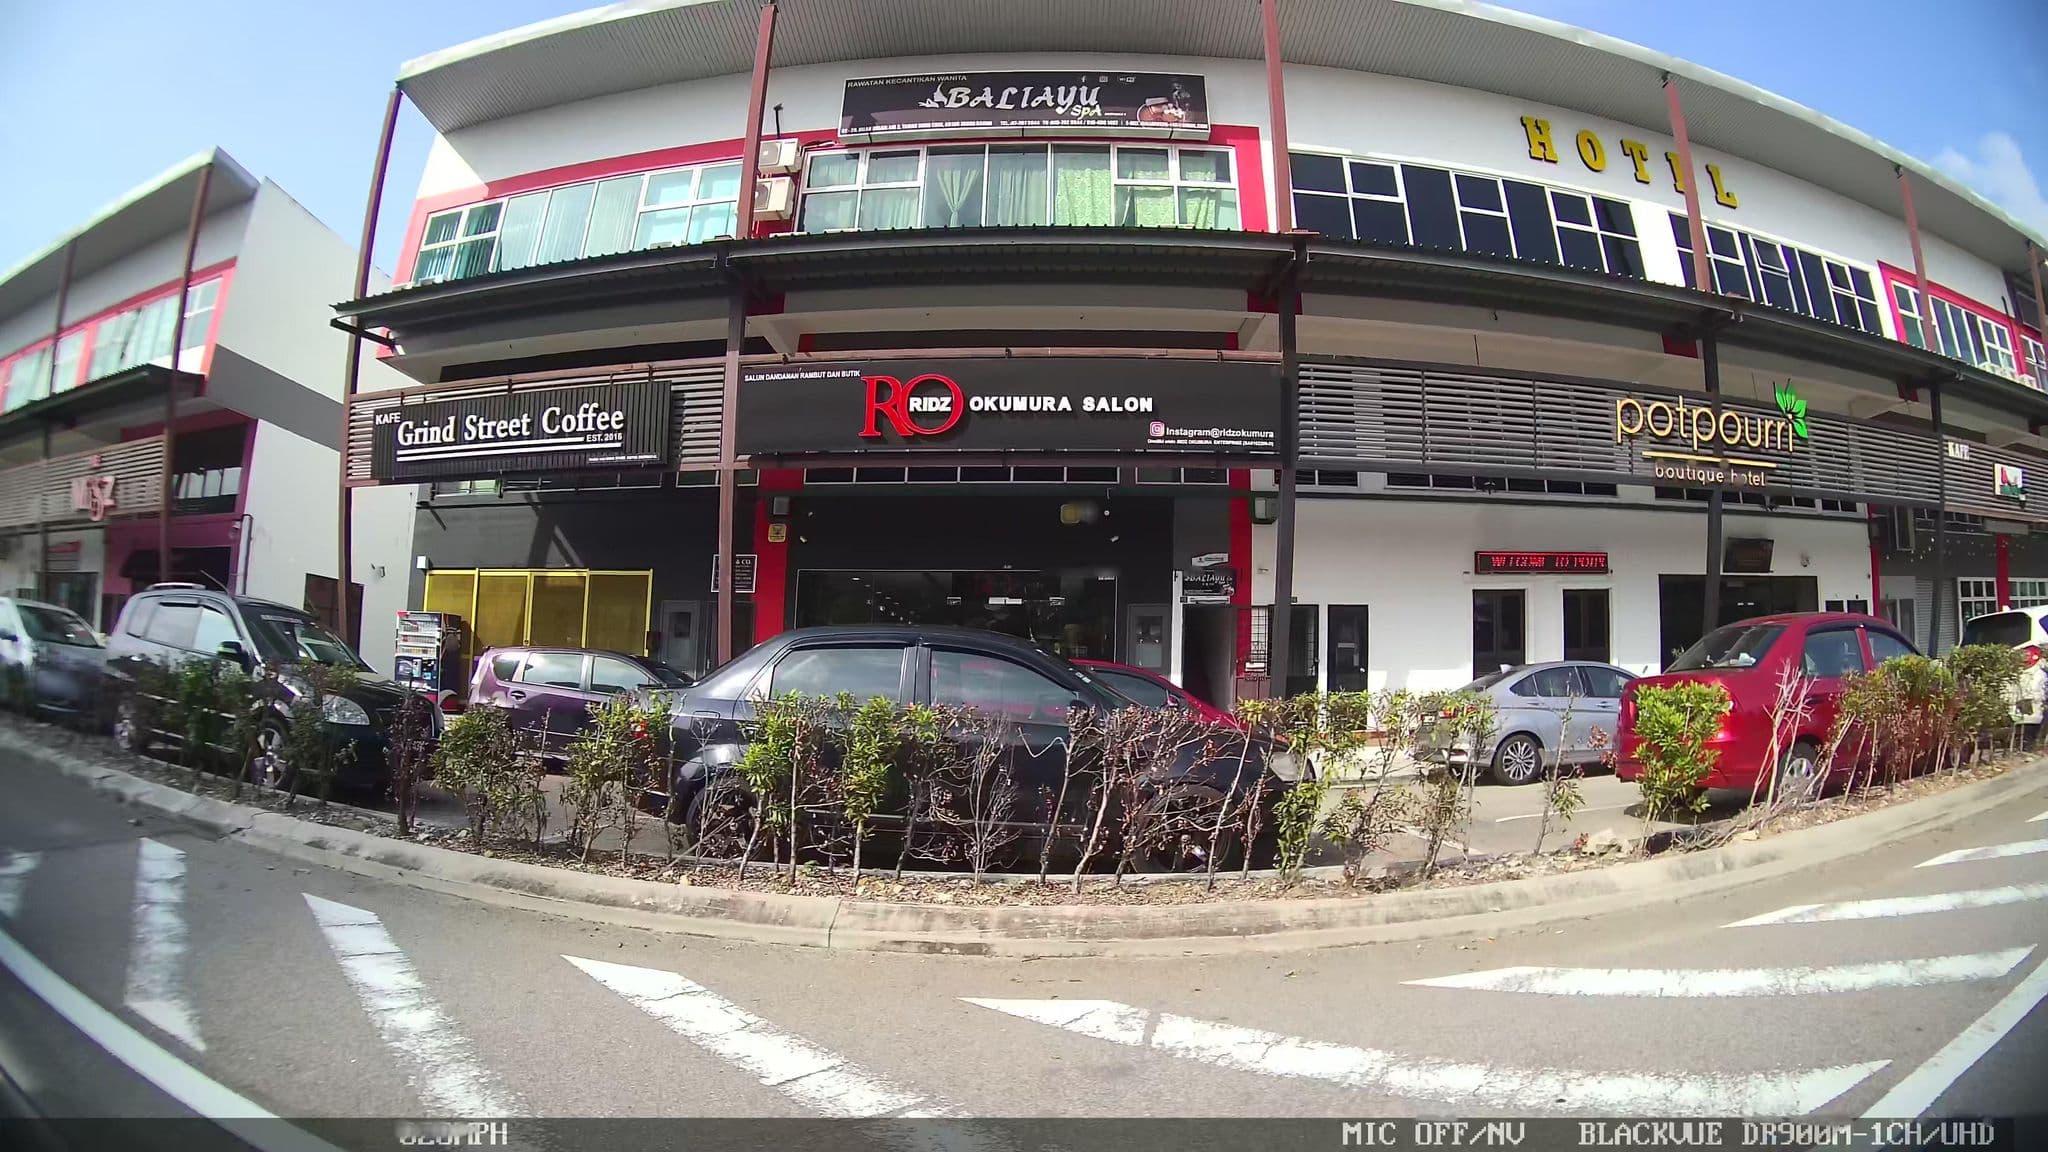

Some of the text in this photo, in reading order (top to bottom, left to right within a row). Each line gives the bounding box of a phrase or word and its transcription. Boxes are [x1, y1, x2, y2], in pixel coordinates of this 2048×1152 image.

[847, 80, 885, 88] RAWATAN
[885, 77, 936, 86] KECANTIKAN
[945, 86, 1101, 115] BALIAYU
[841, 370, 861, 378] BUTIK
[909, 395, 1154, 413] RIDZ OKUMURA SALON
[375, 412, 401, 426] KAFE
[397, 403, 624, 446] Grind Street Coffee
[1616, 395, 1793, 452] potpourri
[1655, 464, 1724, 484] boutique
